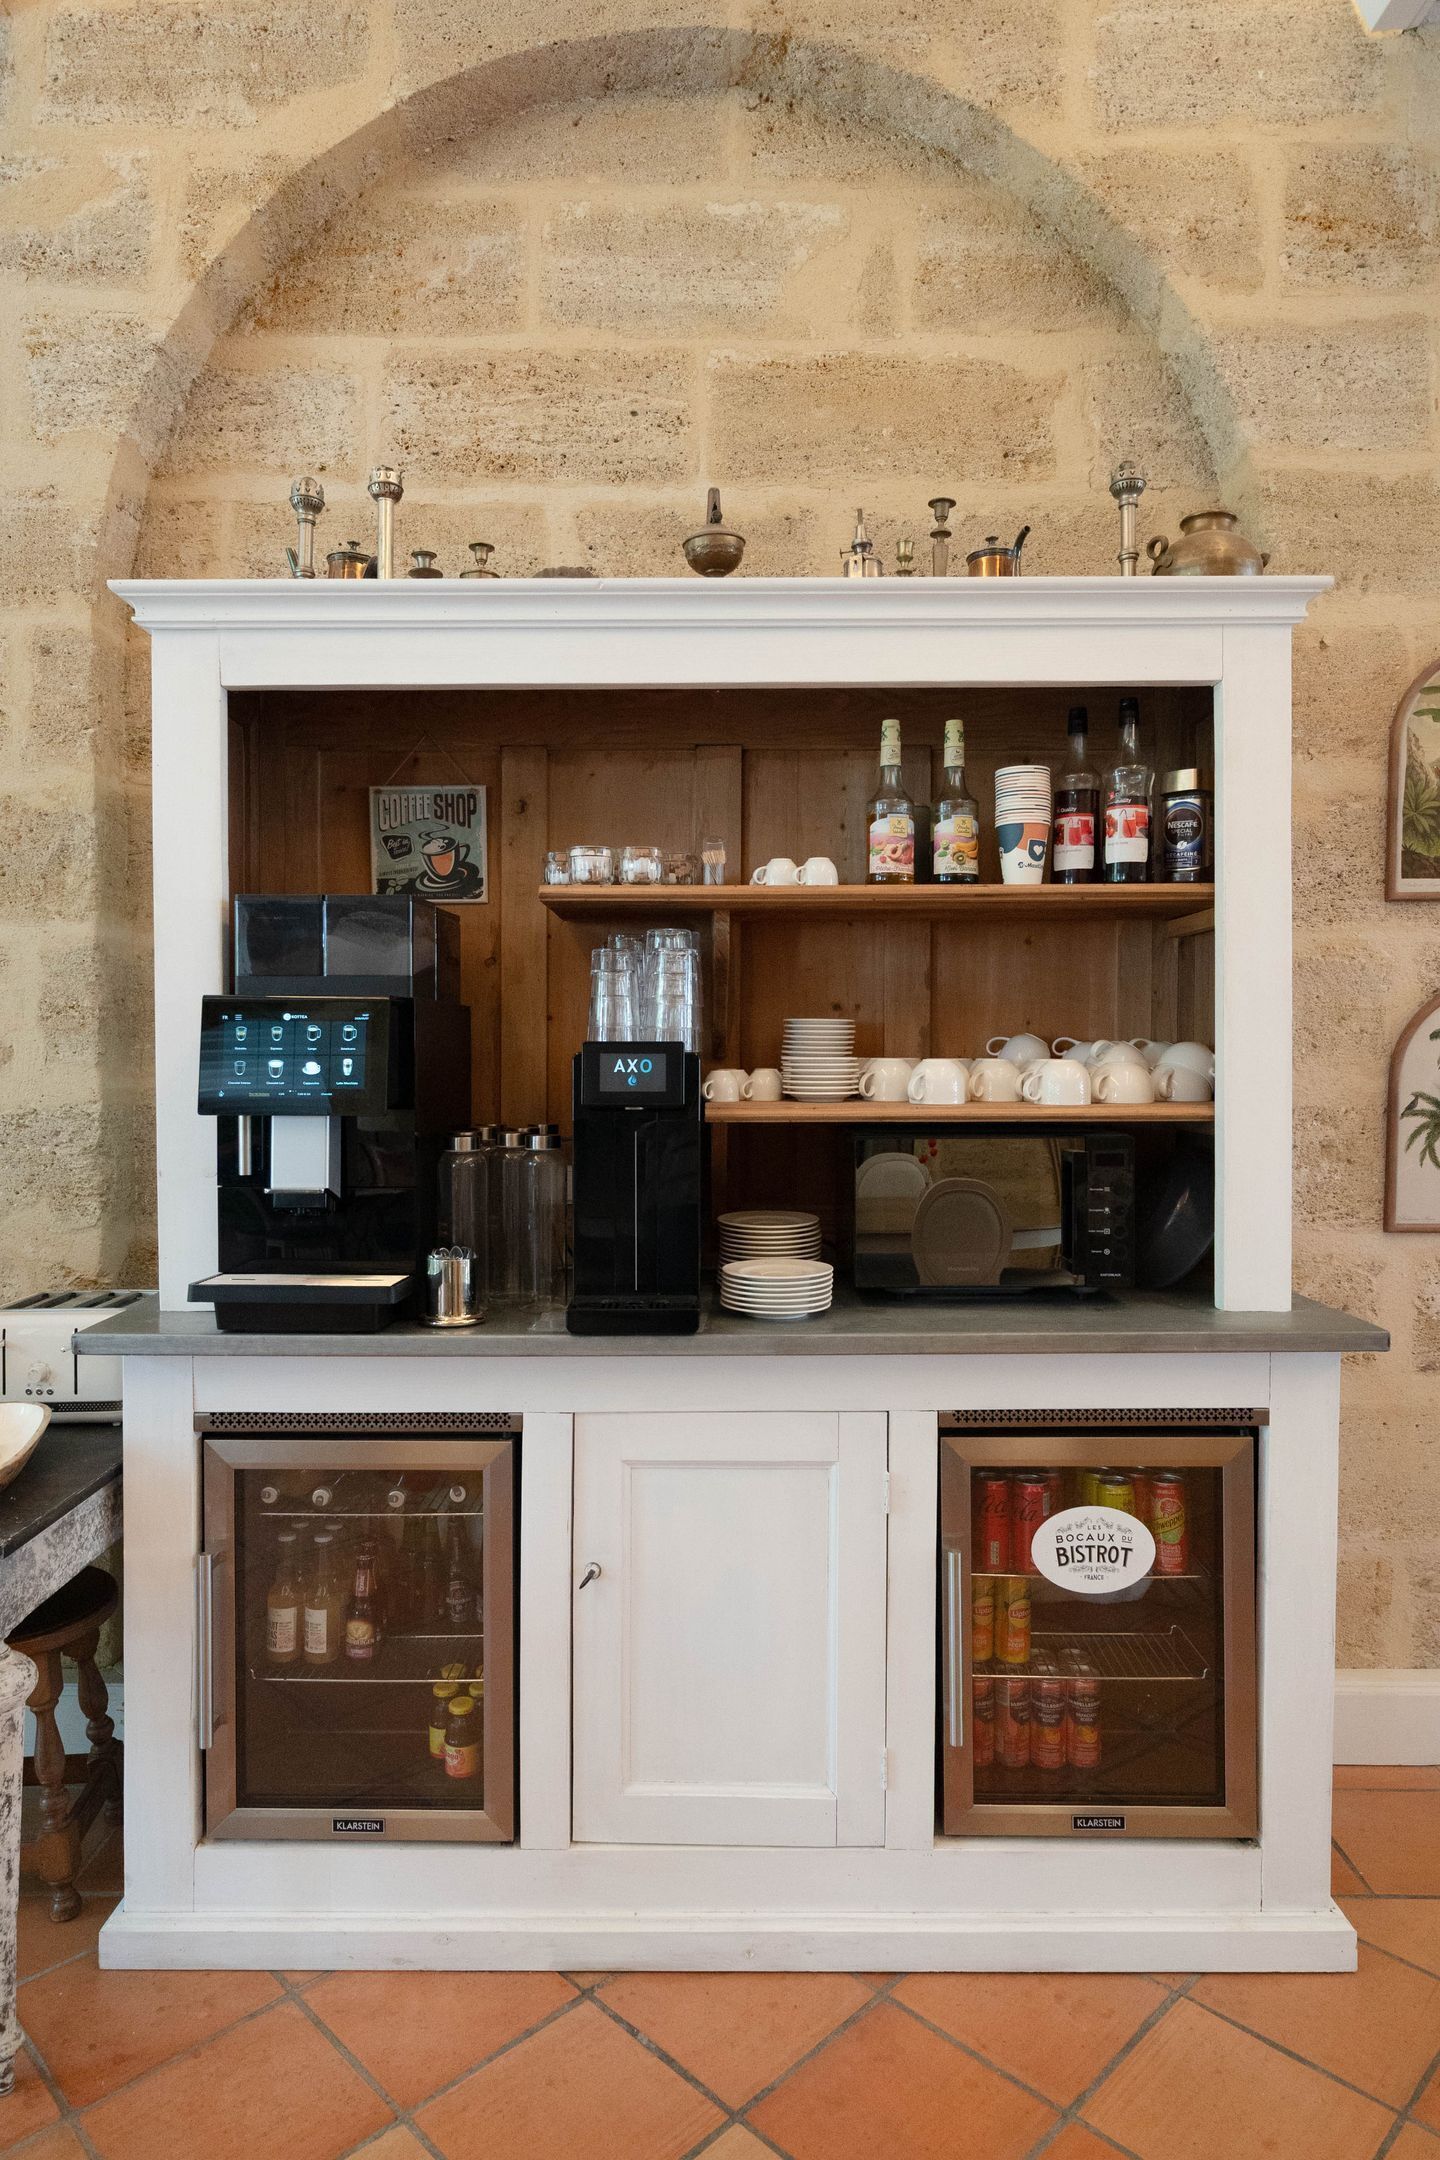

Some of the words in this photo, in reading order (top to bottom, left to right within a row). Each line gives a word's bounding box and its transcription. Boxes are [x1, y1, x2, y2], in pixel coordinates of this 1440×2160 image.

[378, 793, 430, 831] COFFEE
[433, 793, 477, 829] SHOP
[613, 1058, 653, 1073] AXO
[1055, 1533, 1115, 1544] BOCAUX
[1055, 1545, 1134, 1568] BISTROT
[336, 1821, 380, 1831] KLARSTEIN
[1077, 1819, 1121, 1827] KLARSTEIN
